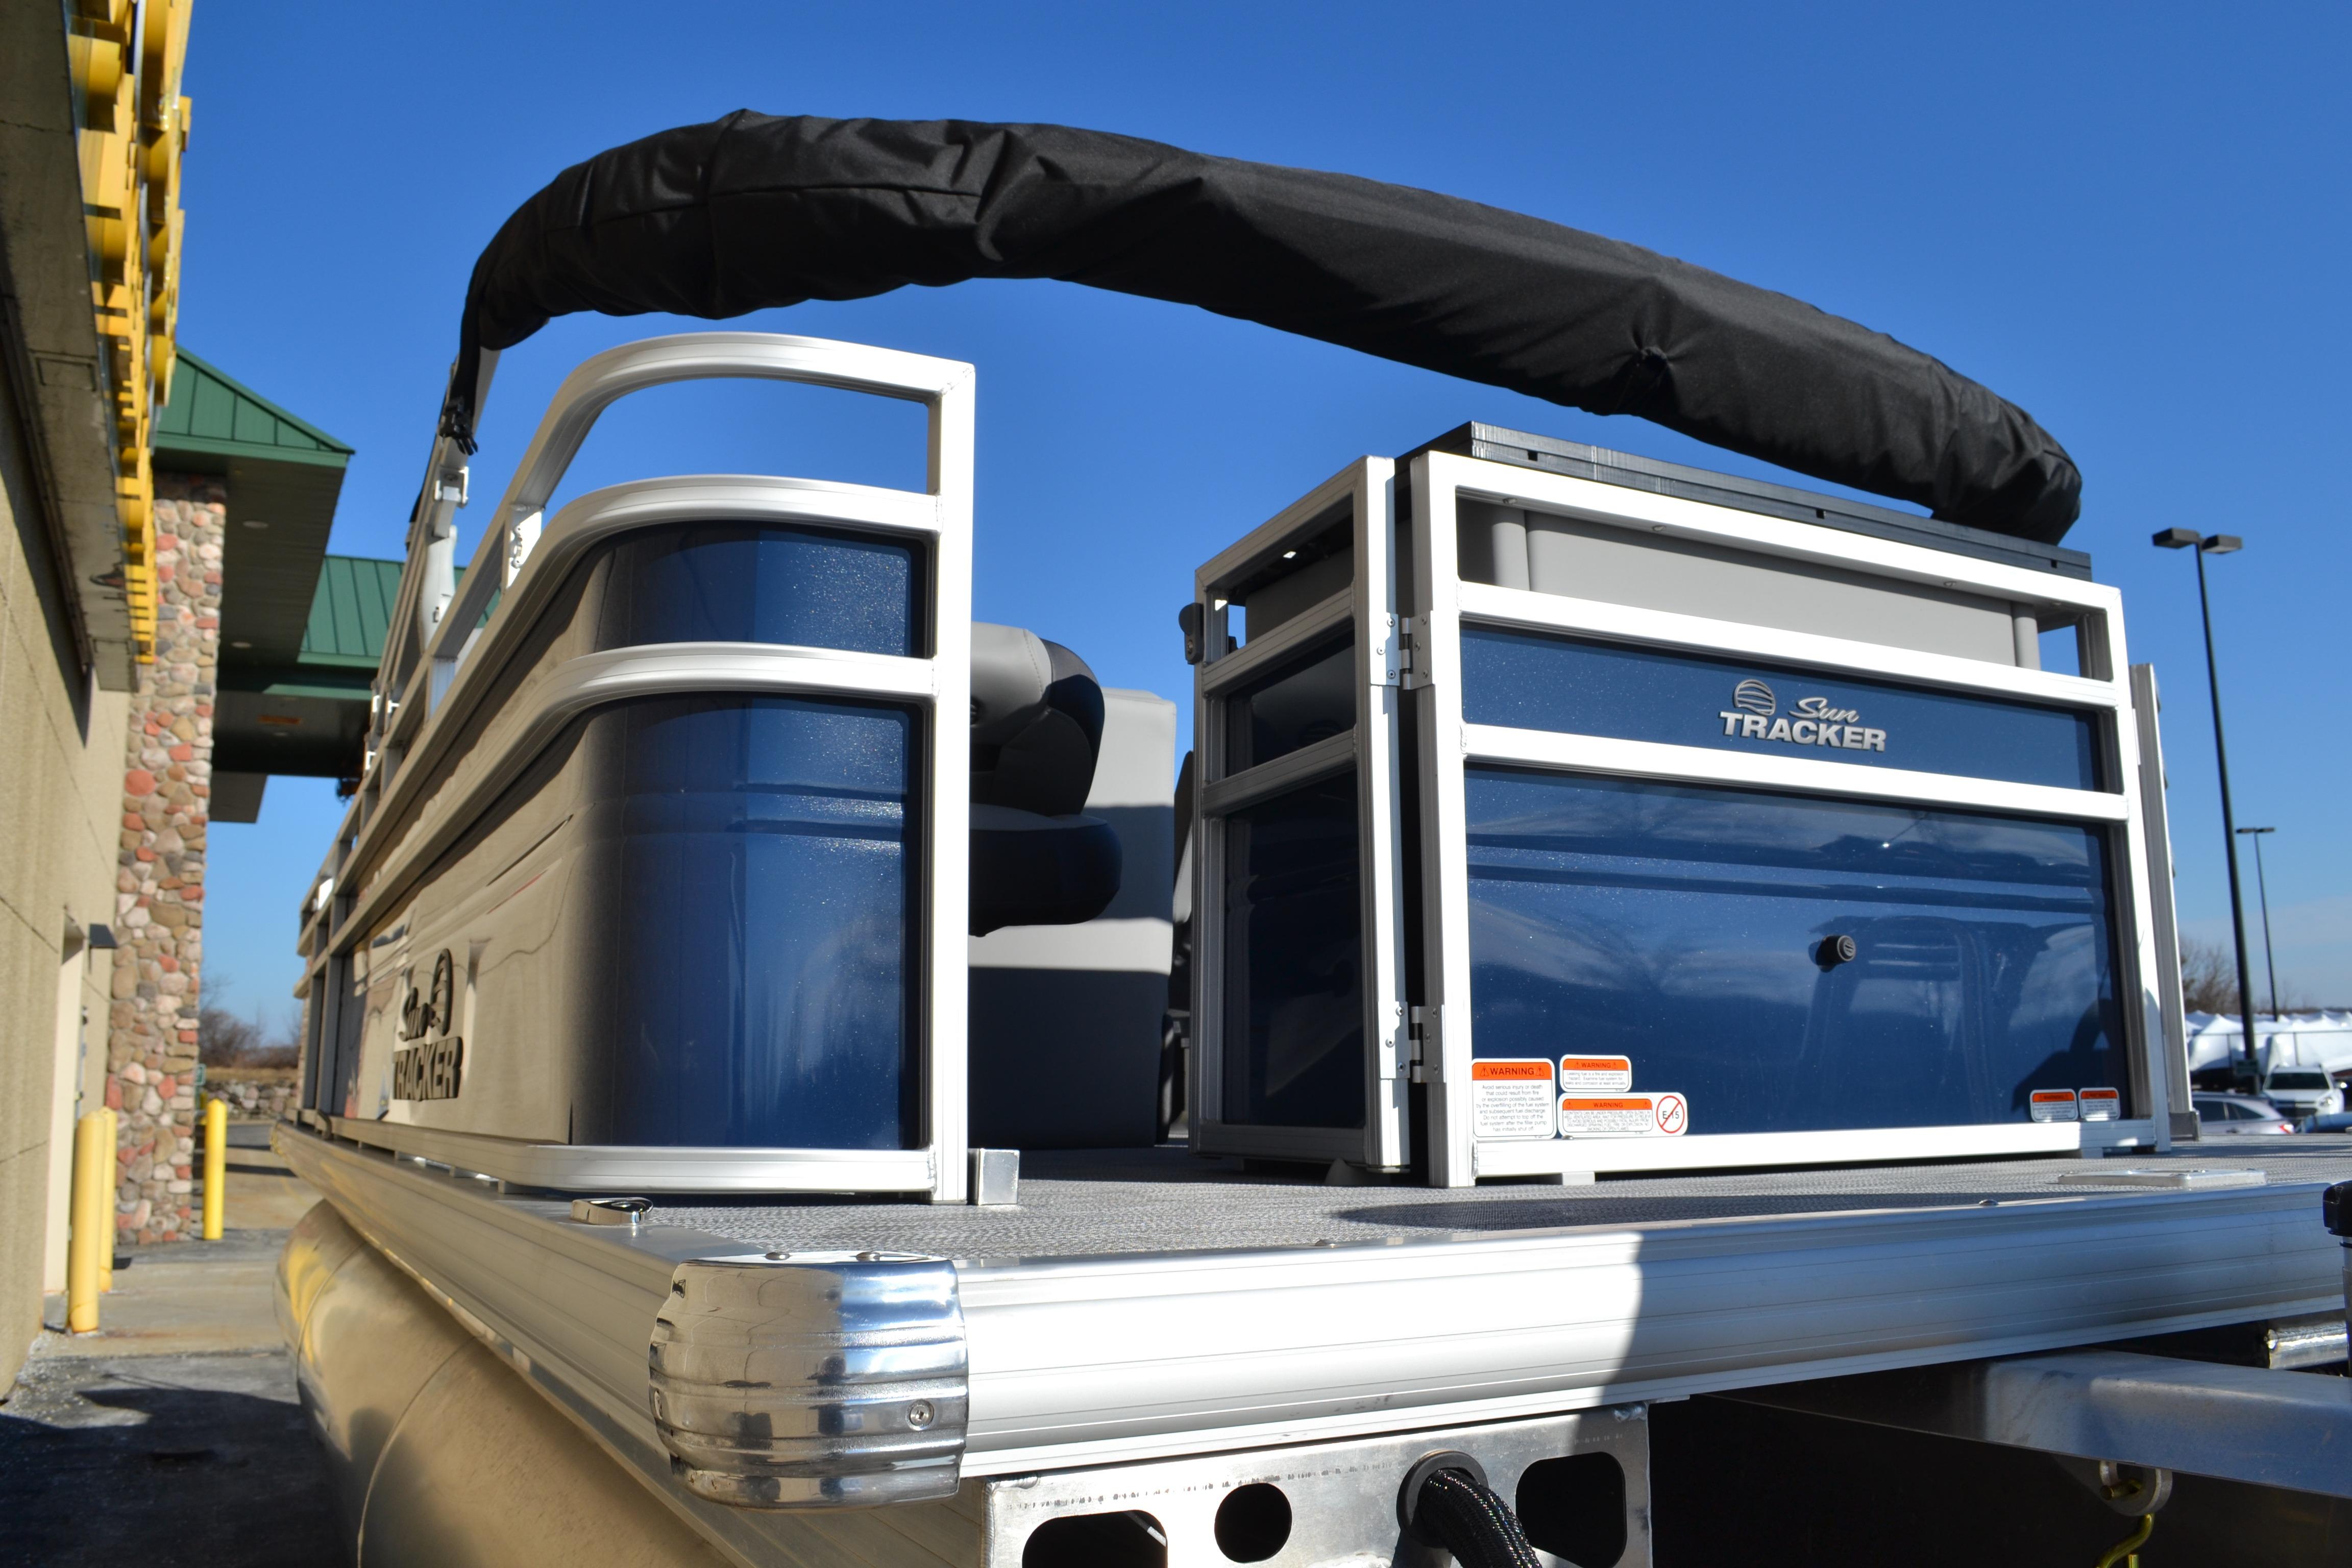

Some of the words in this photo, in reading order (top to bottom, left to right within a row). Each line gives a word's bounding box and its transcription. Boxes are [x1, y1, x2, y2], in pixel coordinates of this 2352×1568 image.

[1788, 697, 1859, 724] Sun
[1719, 711, 1886, 752] TRACKER
[393, 1036, 463, 1102] TRACKER
